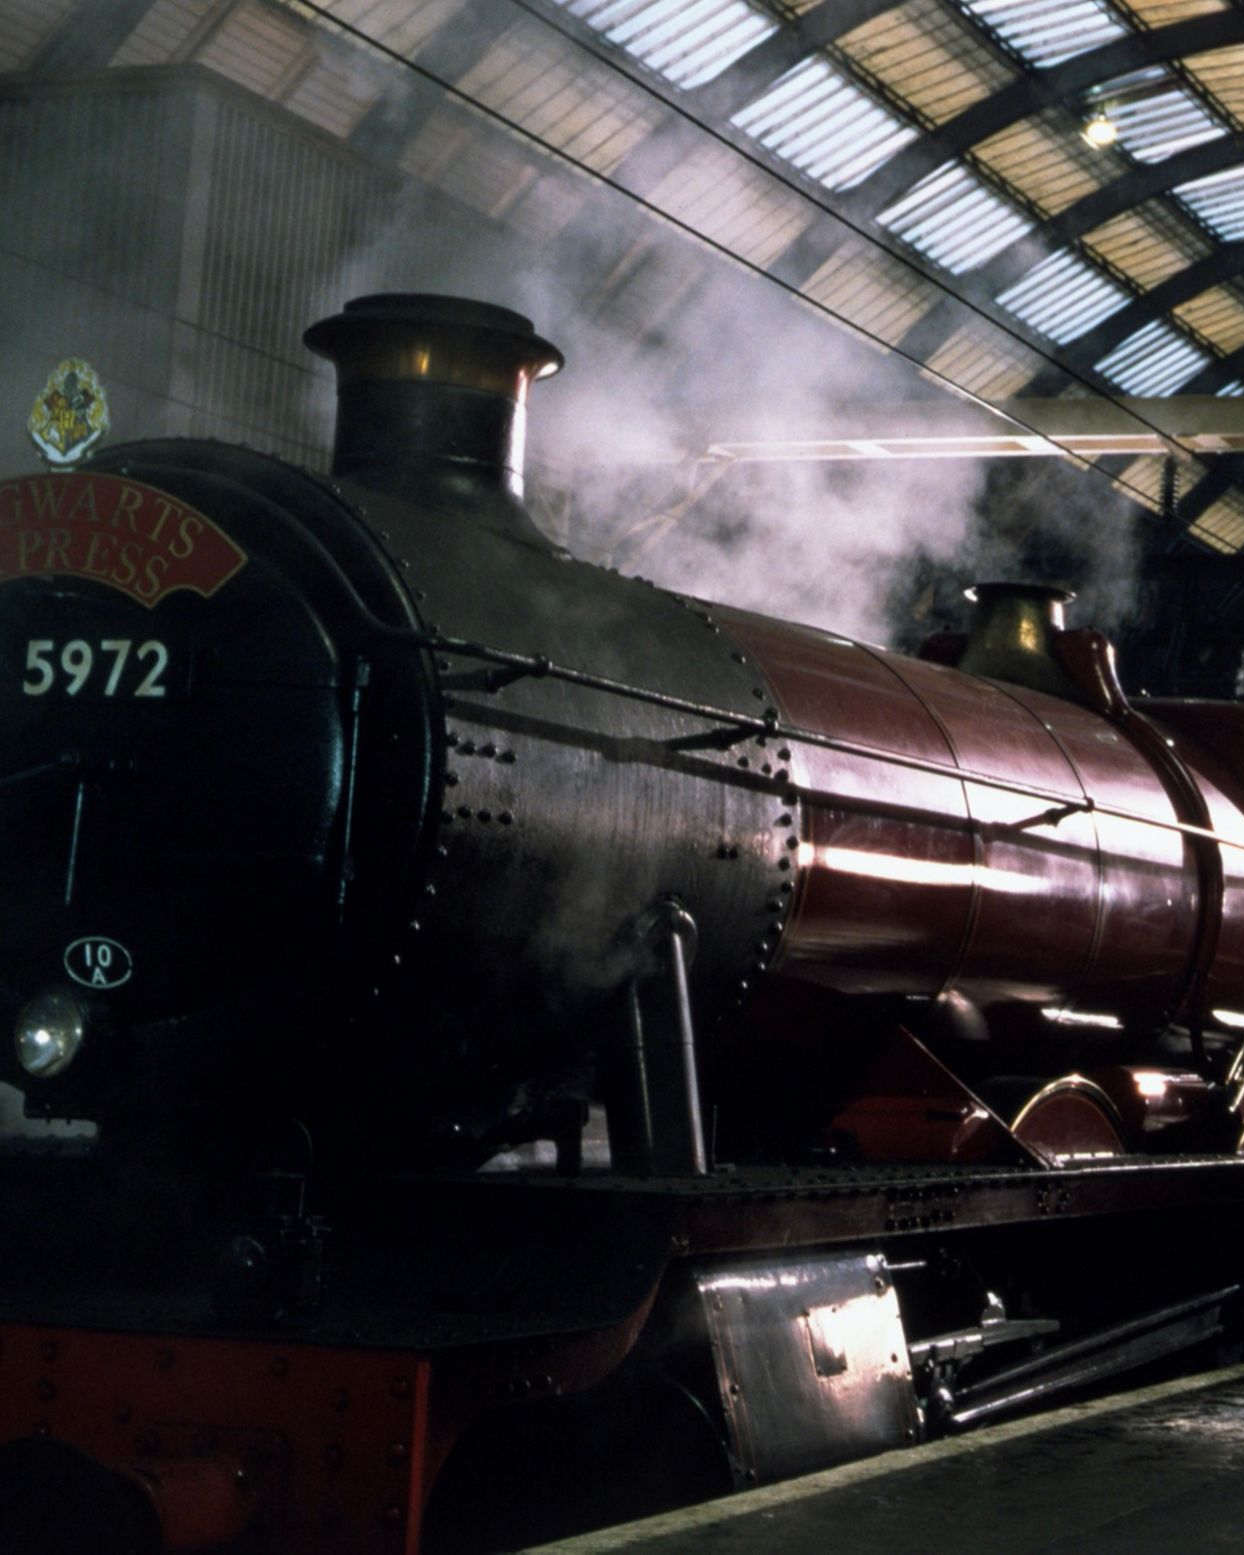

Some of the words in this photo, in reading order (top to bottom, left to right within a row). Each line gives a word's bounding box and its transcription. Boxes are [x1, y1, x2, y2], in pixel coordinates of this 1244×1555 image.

[0, 528, 169, 598] PRESS
[23, 640, 168, 697] 5972
[85, 943, 112, 967] 10
[91, 966, 107, 985] A
